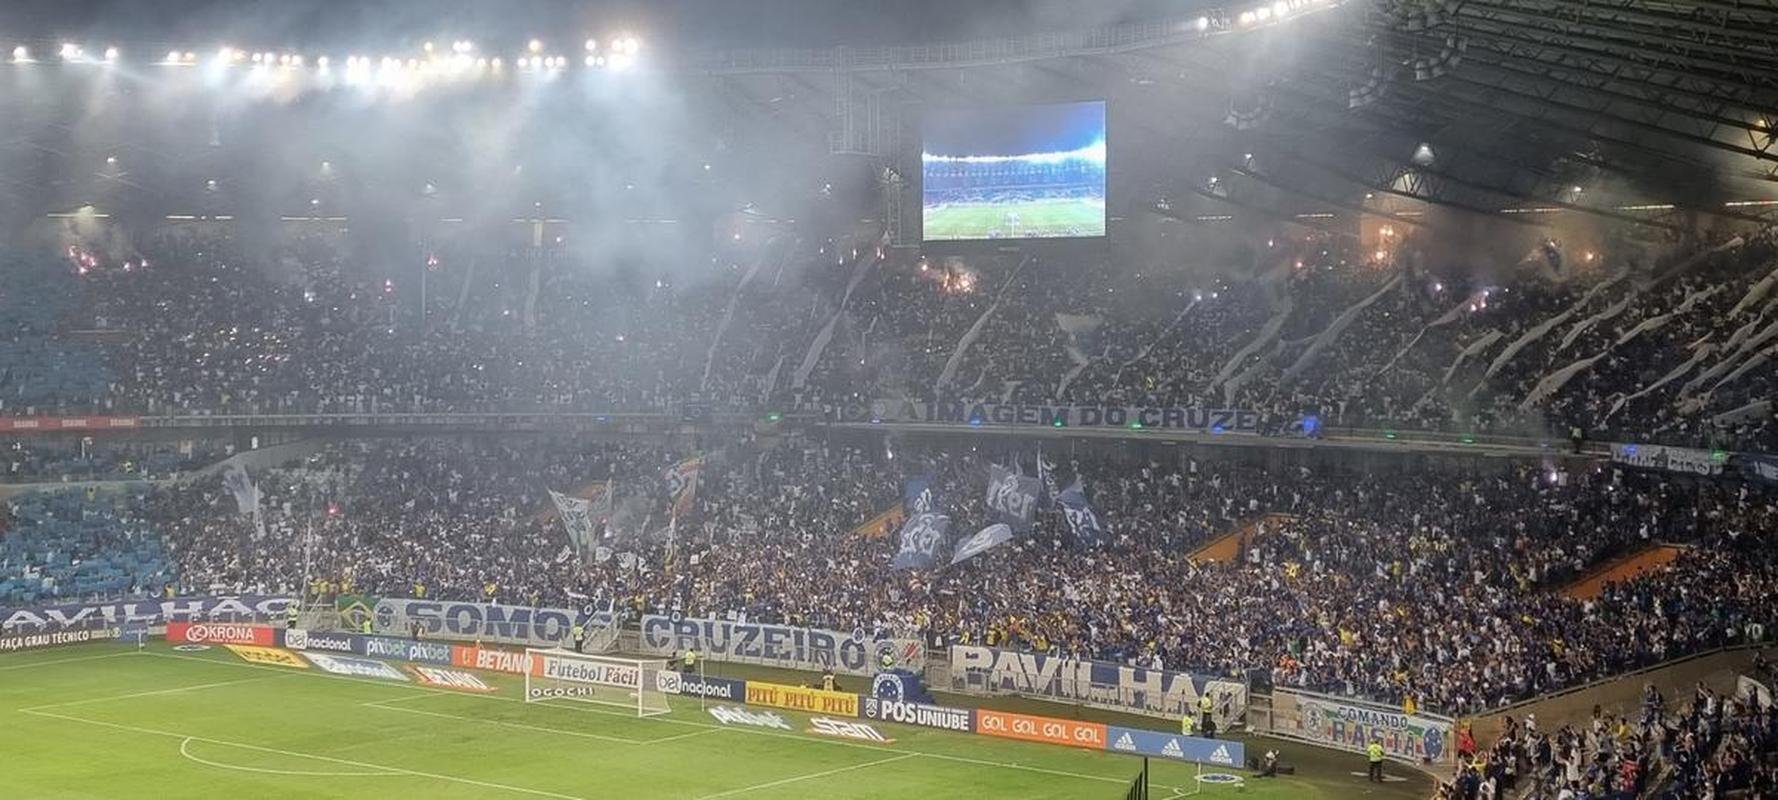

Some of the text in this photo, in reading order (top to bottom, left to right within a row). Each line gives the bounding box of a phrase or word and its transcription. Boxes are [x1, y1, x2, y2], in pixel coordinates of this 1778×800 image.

[926, 400, 1069, 427] IMAGEM
[1079, 406, 1128, 427] DO
[1139, 407, 1257, 431] CRUZE
[0, 638, 23, 650] FAÇA
[25, 634, 50, 646] GRAU
[52, 630, 89, 643] TÉCNICO
[208, 627, 254, 640] KRONA
[644, 617, 866, 671] CRUZEIRO
[366, 637, 449, 661] pixbet pixbet
[476, 651, 534, 674] BETANO
[547, 660, 639, 686] Futebol Fácil
[531, 687, 594, 697] OGOCHI
[748, 685, 855, 714] PITÚ PITÚ PITÚ
[917, 709, 969, 731] UNIUBE
[982, 715, 1101, 743] GOL GOL GOL GOL
[1338, 707, 1408, 729] COMANDO
